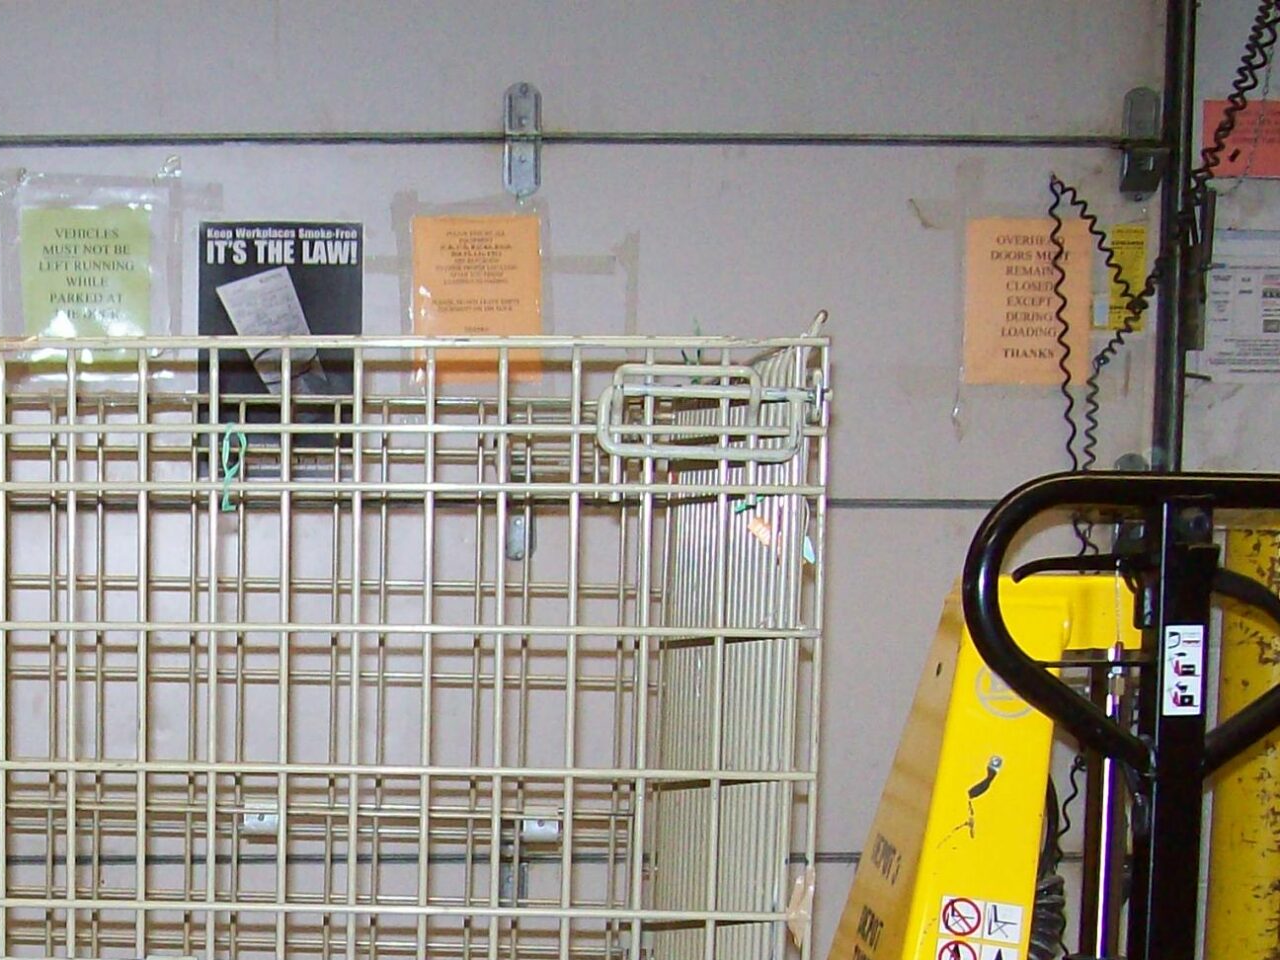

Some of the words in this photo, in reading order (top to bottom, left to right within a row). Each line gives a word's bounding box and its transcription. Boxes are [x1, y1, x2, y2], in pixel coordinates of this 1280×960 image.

[55, 228, 120, 239] VEHICLES
[207, 227, 233, 240] Keep
[235, 227, 295, 240] Workplaces
[298, 227, 358, 239] Smoke-Free
[42, 245, 78, 255] MUST
[83, 244, 110, 255] NOT
[114, 245, 131, 255] BE
[206, 240, 247, 264] IT'S
[254, 240, 295, 264] THE
[302, 240, 358, 264] LAW!
[990, 250, 1032, 260] DOORS
[39, 261, 68, 271] LEFT
[74, 261, 134, 271] RUNNING
[1006, 265, 1054, 276] REMAIN
[66, 277, 107, 287] WHILE
[1006, 281, 1055, 291] CLOSED
[50, 293, 103, 303] PARKED
[1006, 296, 1052, 306] EXCEPT
[1006, 312, 1053, 322] DURING
[1001, 327, 1057, 337] LOADING
[1003, 348, 1055, 358] THANKS
